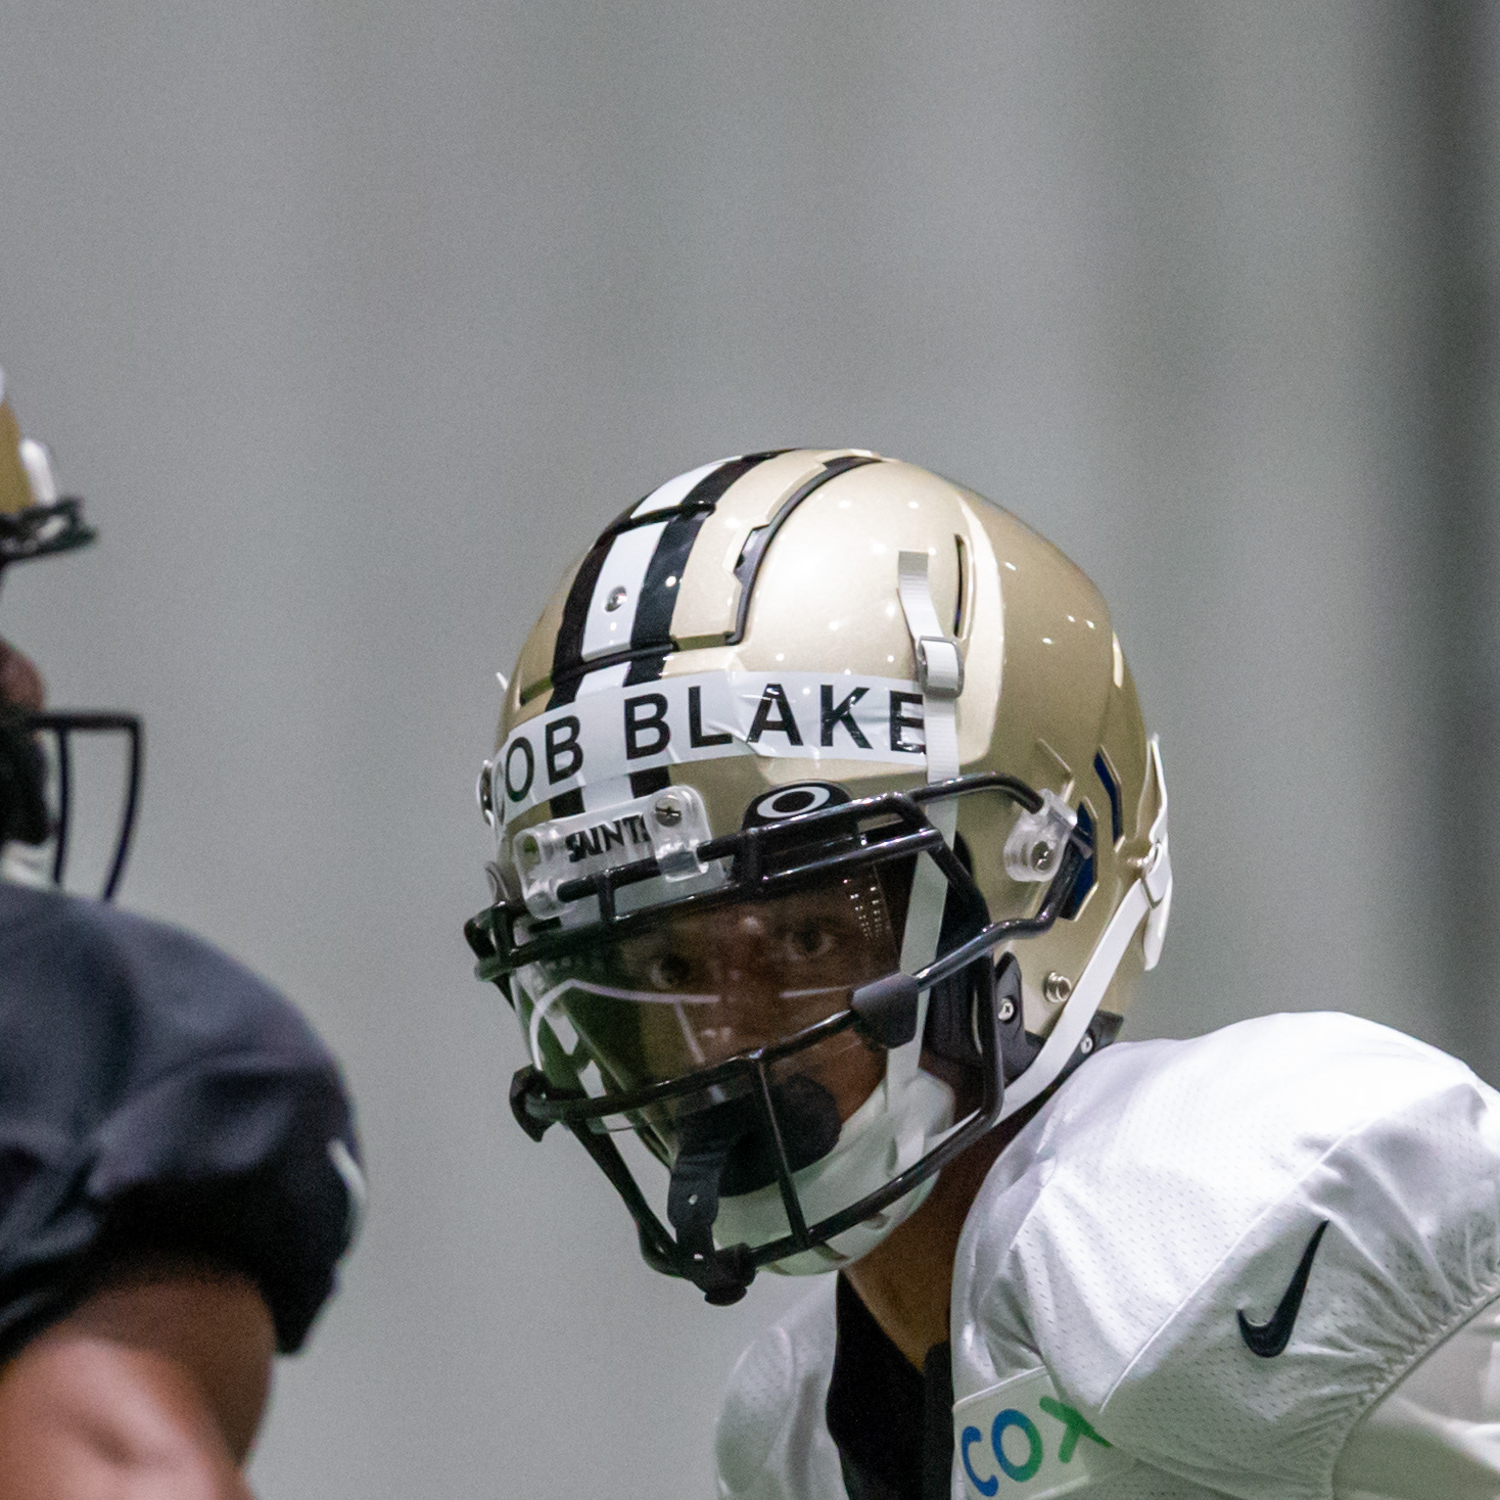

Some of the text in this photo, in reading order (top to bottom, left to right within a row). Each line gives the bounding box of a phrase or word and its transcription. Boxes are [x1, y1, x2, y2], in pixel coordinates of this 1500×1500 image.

[494, 683, 926, 825] OB BLAKE
[961, 1396, 1112, 1497] COX
